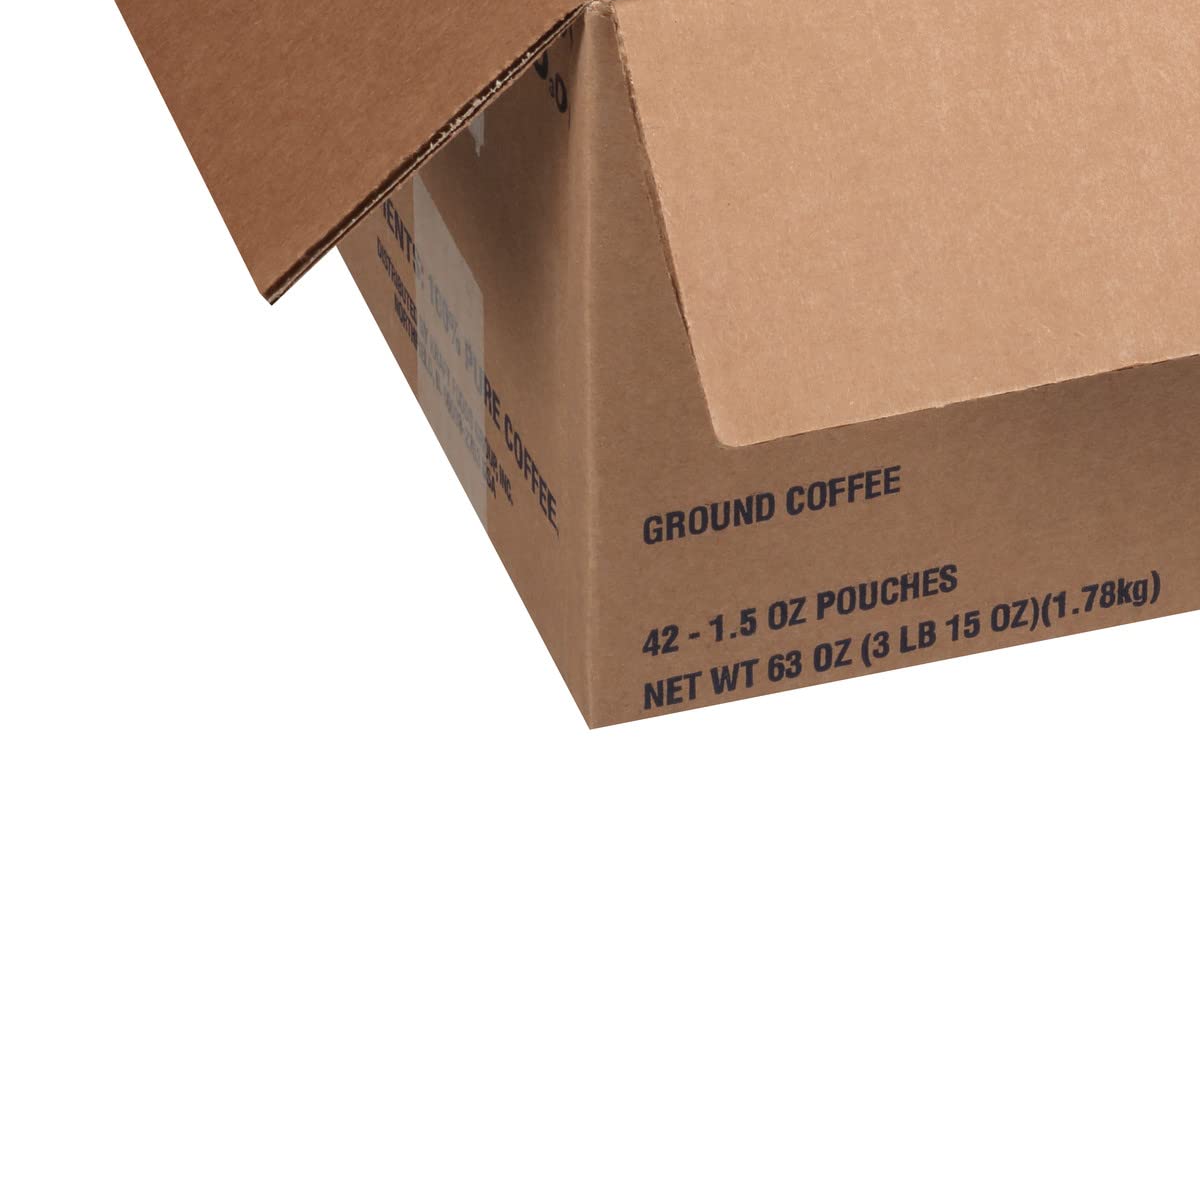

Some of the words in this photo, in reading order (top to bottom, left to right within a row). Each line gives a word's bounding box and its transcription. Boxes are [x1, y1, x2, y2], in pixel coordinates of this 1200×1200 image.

[642, 491, 776, 545] GROUND
[786, 465, 902, 516] COFFEE
[642, 624, 679, 657] 42
[709, 607, 757, 644] 1.5
[768, 597, 808, 631] OZ
[816, 564, 958, 620] POUCHES
[643, 670, 703, 710] NET
[710, 658, 759, 696] WT
[767, 650, 802, 682] 63
[813, 637, 853, 672] OZ
[860, 631, 890, 668] (3
[899, 623, 936, 654] LB
[945, 612, 980, 643] 15
